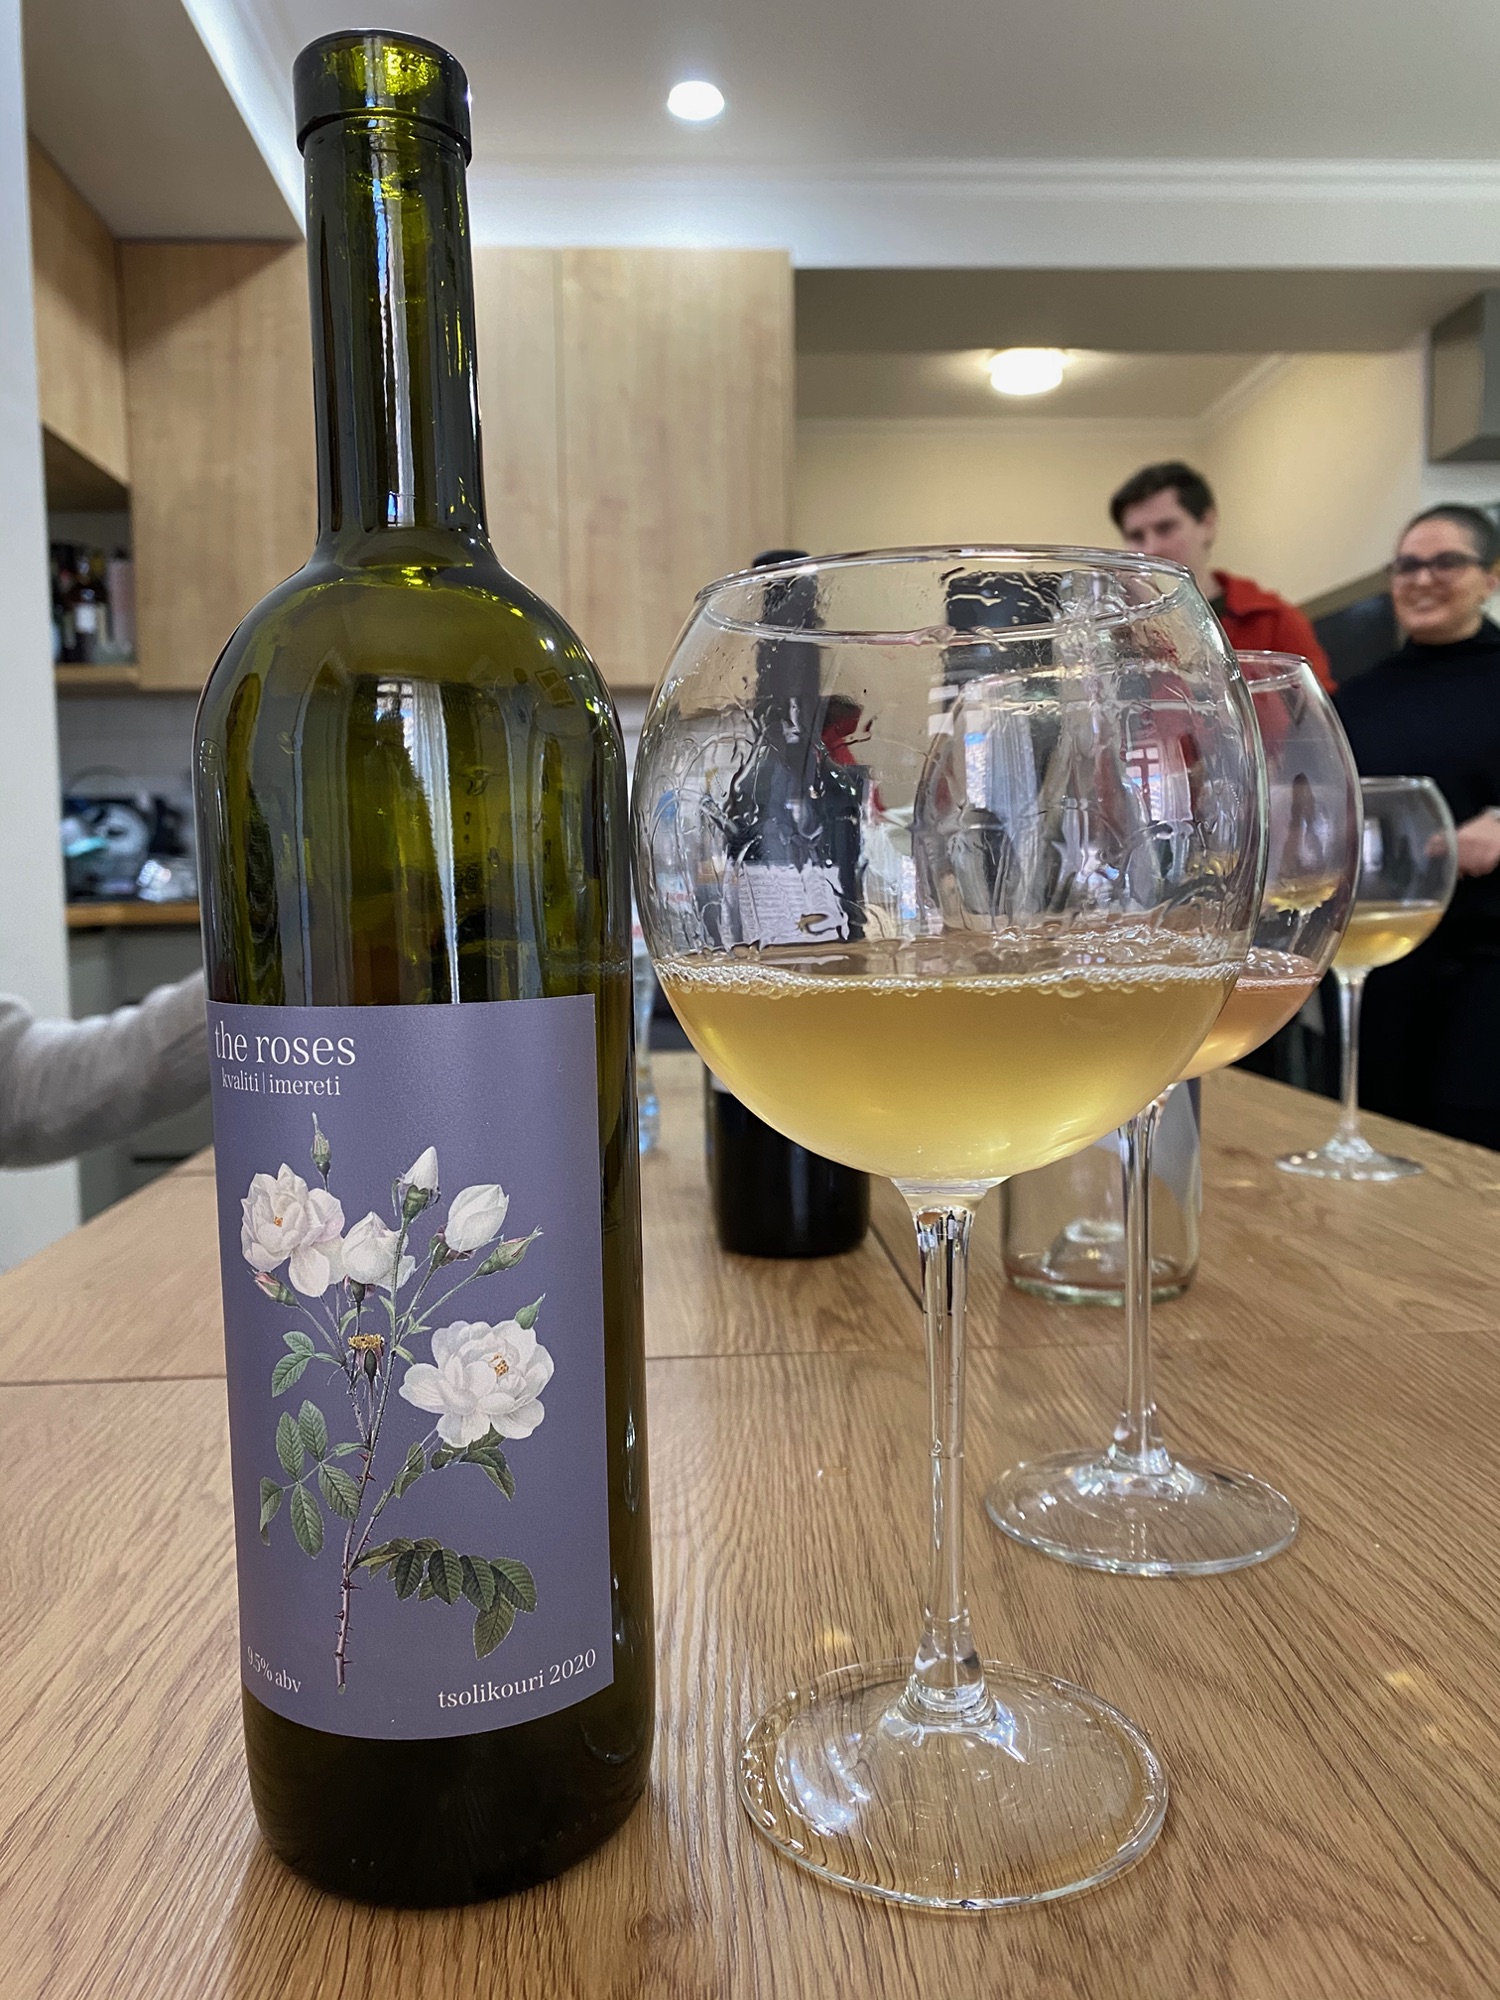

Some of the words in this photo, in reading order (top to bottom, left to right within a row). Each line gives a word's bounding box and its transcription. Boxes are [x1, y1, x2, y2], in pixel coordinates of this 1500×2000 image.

[214, 1020, 248, 1062] the
[255, 1036, 356, 1066] roses
[221, 1066, 260, 1093] kvaliti
[269, 1073, 341, 1096] imereti
[275, 1669, 302, 1694] abv
[437, 1669, 545, 1709] tsolikouri
[549, 1648, 596, 1686] 2020
